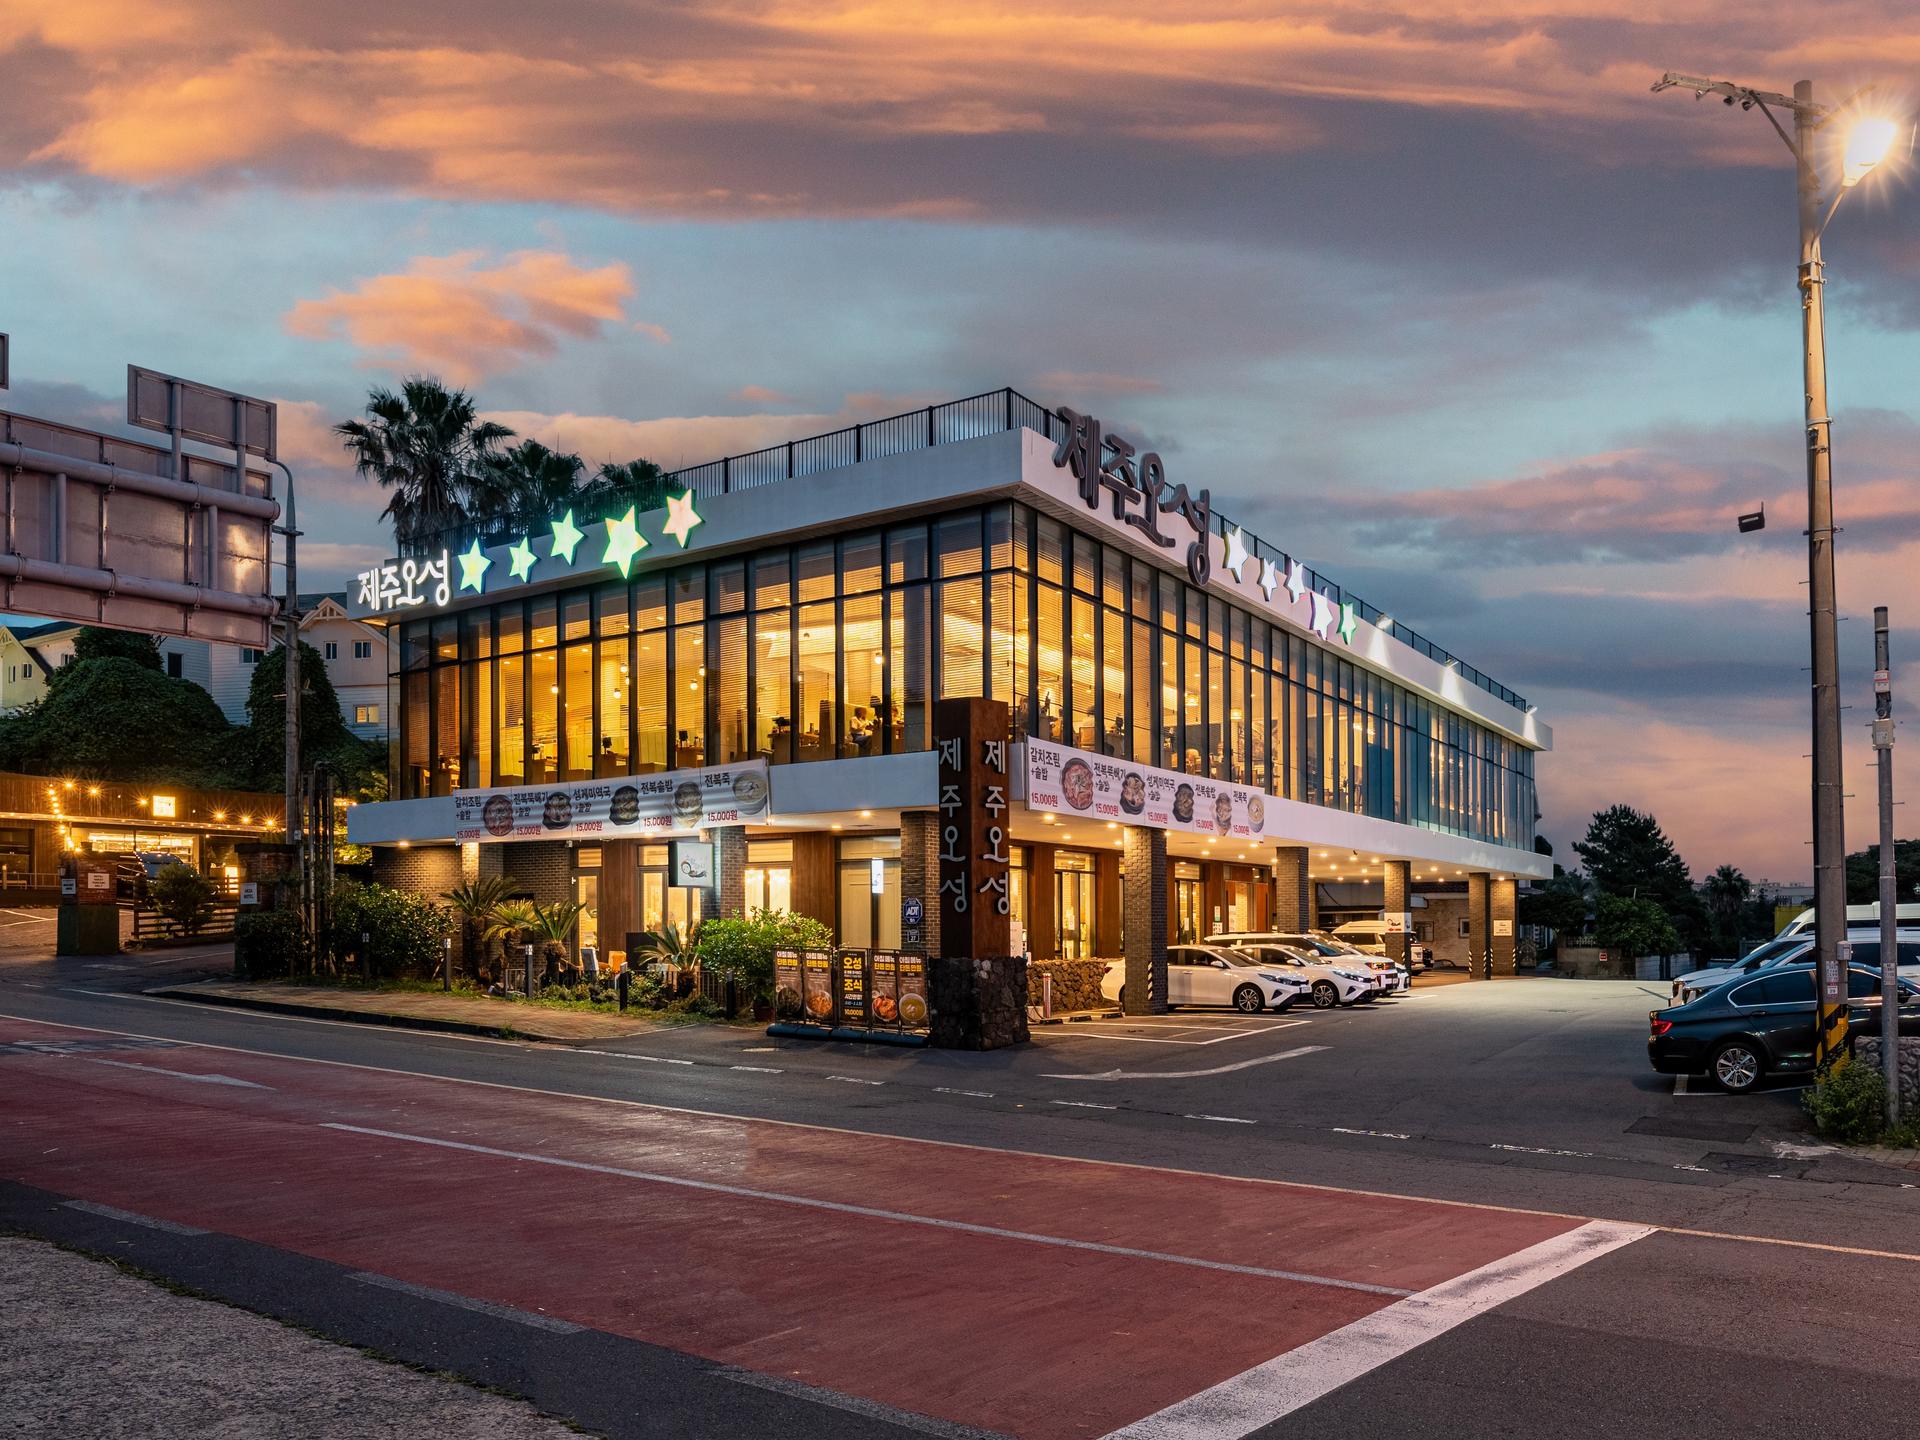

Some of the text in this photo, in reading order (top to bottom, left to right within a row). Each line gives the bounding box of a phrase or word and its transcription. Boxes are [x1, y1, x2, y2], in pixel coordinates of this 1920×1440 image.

[1053, 406, 1210, 586] 제주오성
[358, 549, 449, 607] 제주오성
[1030, 747, 1061, 769] 갈치조림
[640, 779, 674, 795] 전복솥밥
[704, 772, 731, 788] 전복죽
[573, 785, 611, 801] 성게미역국
[1031, 792, 1059, 808] 15,000원
[1233, 790, 1248, 804] 전복죽
[455, 796, 481, 808] 갈치조림
[707, 810, 738, 822] 15,000원
[1095, 803, 1119, 817] 15,000원
[576, 821, 603, 832] 15,000원
[643, 816, 673, 827] 15,000원
[939, 737, 967, 912] 제주오성
[979, 740, 1010, 915] 제주오성
[905, 906, 919, 916] ADT
[843, 957, 862, 970] 오성
[844, 979, 863, 992] 조식
